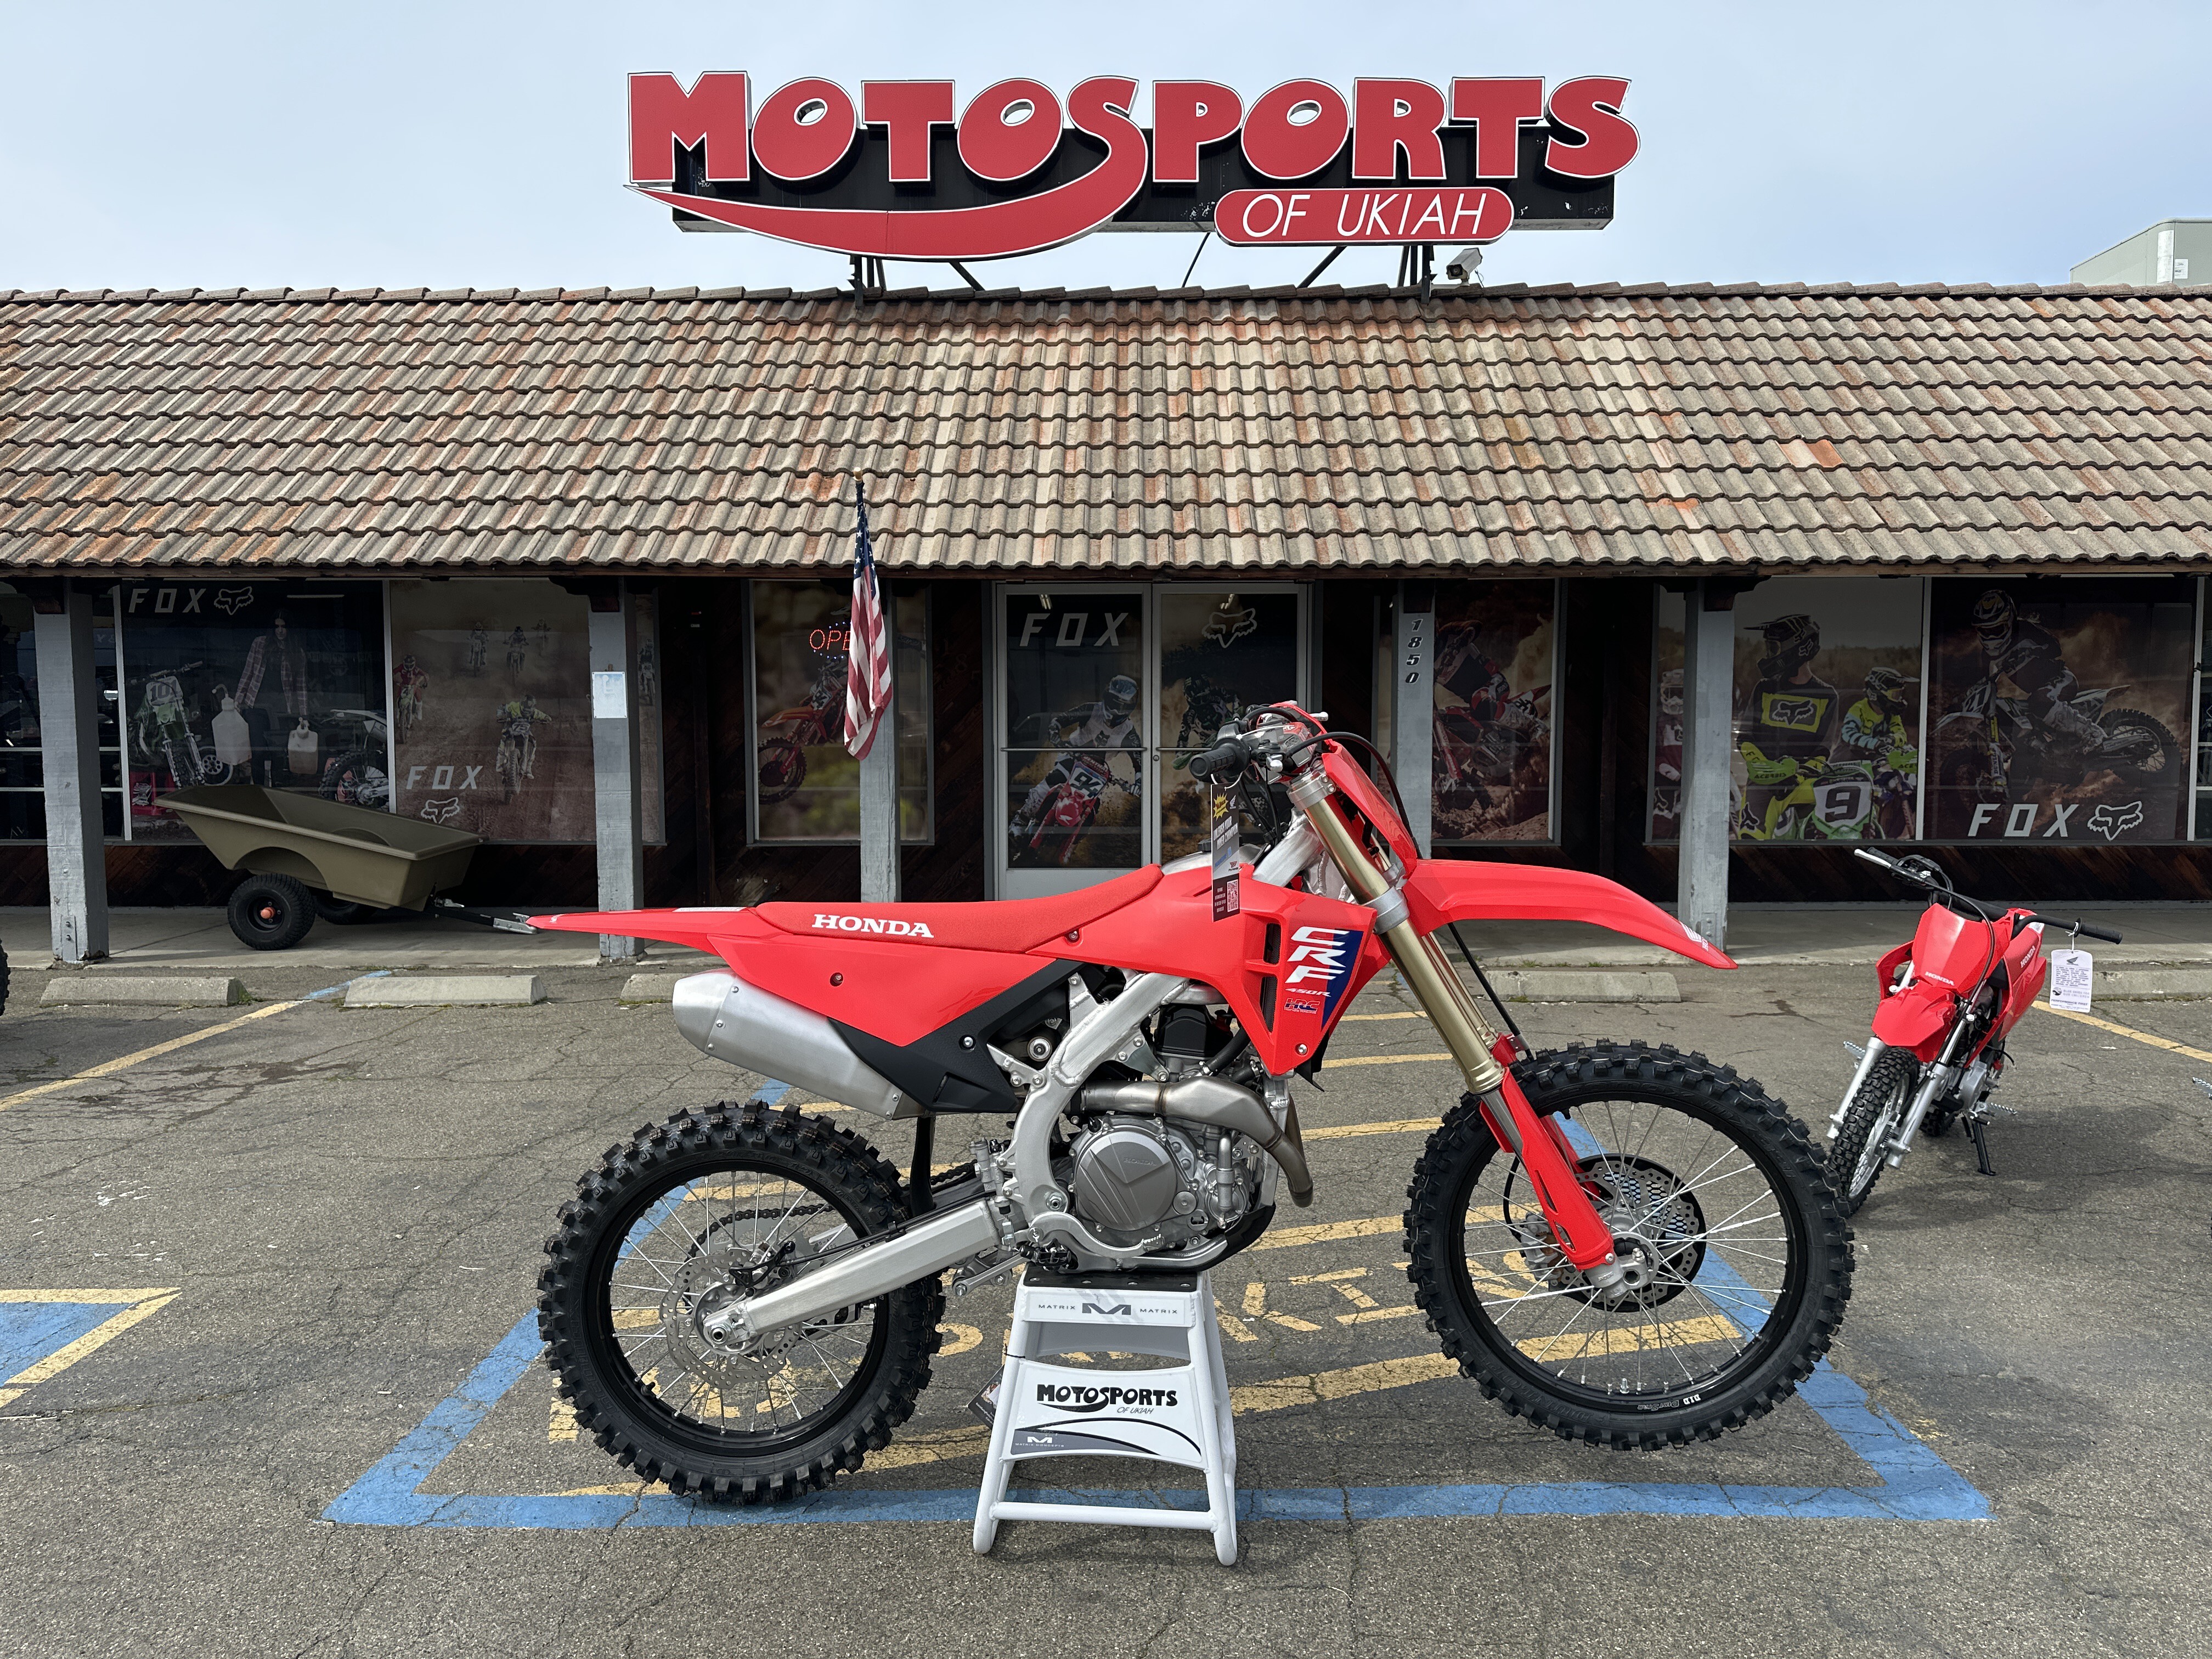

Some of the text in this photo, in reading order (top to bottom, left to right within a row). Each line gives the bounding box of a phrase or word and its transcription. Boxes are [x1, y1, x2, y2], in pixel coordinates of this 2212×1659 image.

[625, 71, 1640, 260] MOTOSPORTS
[1241, 192, 1487, 237] OF UKIAH
[128, 588, 207, 613] FOX
[809, 629, 850, 651] OPE
[1019, 613, 1129, 647] FOX
[1405, 618, 1424, 685] 1850
[405, 765, 483, 789] FOX
[1825, 786, 1861, 822] 9
[1968, 804, 2079, 837] FOX
[811, 913, 934, 938] HONDA
[1285, 926, 1350, 984] CRF
[2019, 945, 2036, 969] HONDA
[1925, 970, 1955, 987] HONDA
[1284, 997, 1321, 1012] HRC
[1285, 988, 1331, 997] 450R
[1037, 1384, 1178, 1413] MOTOSPORTS
[1130, 1407, 1154, 1415] UKIAH
